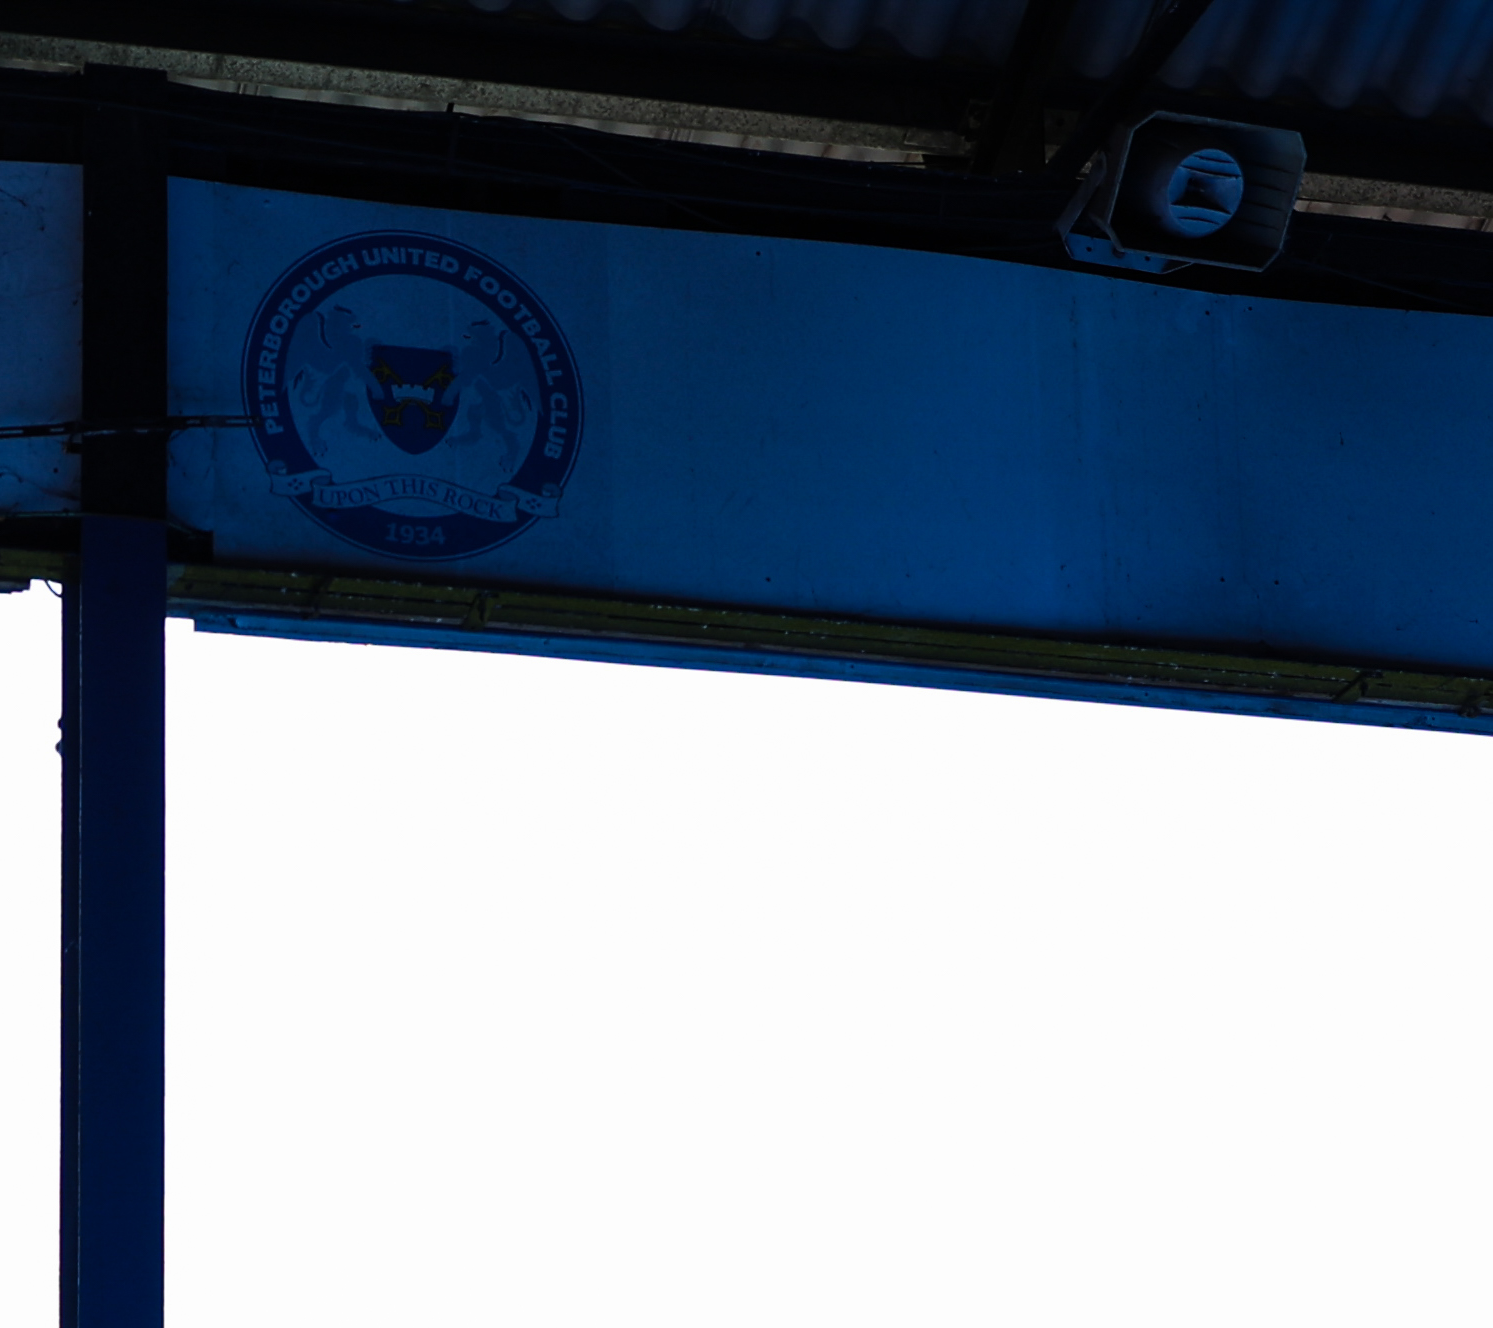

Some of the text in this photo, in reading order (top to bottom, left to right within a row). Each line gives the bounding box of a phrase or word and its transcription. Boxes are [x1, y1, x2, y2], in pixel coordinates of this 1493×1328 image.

[256, 246, 569, 460] PETERBOROUGH UNITED FOOTBALL CLUB
[321, 478, 504, 521] UPON THIS ROCK
[384, 523, 447, 546] 1934
